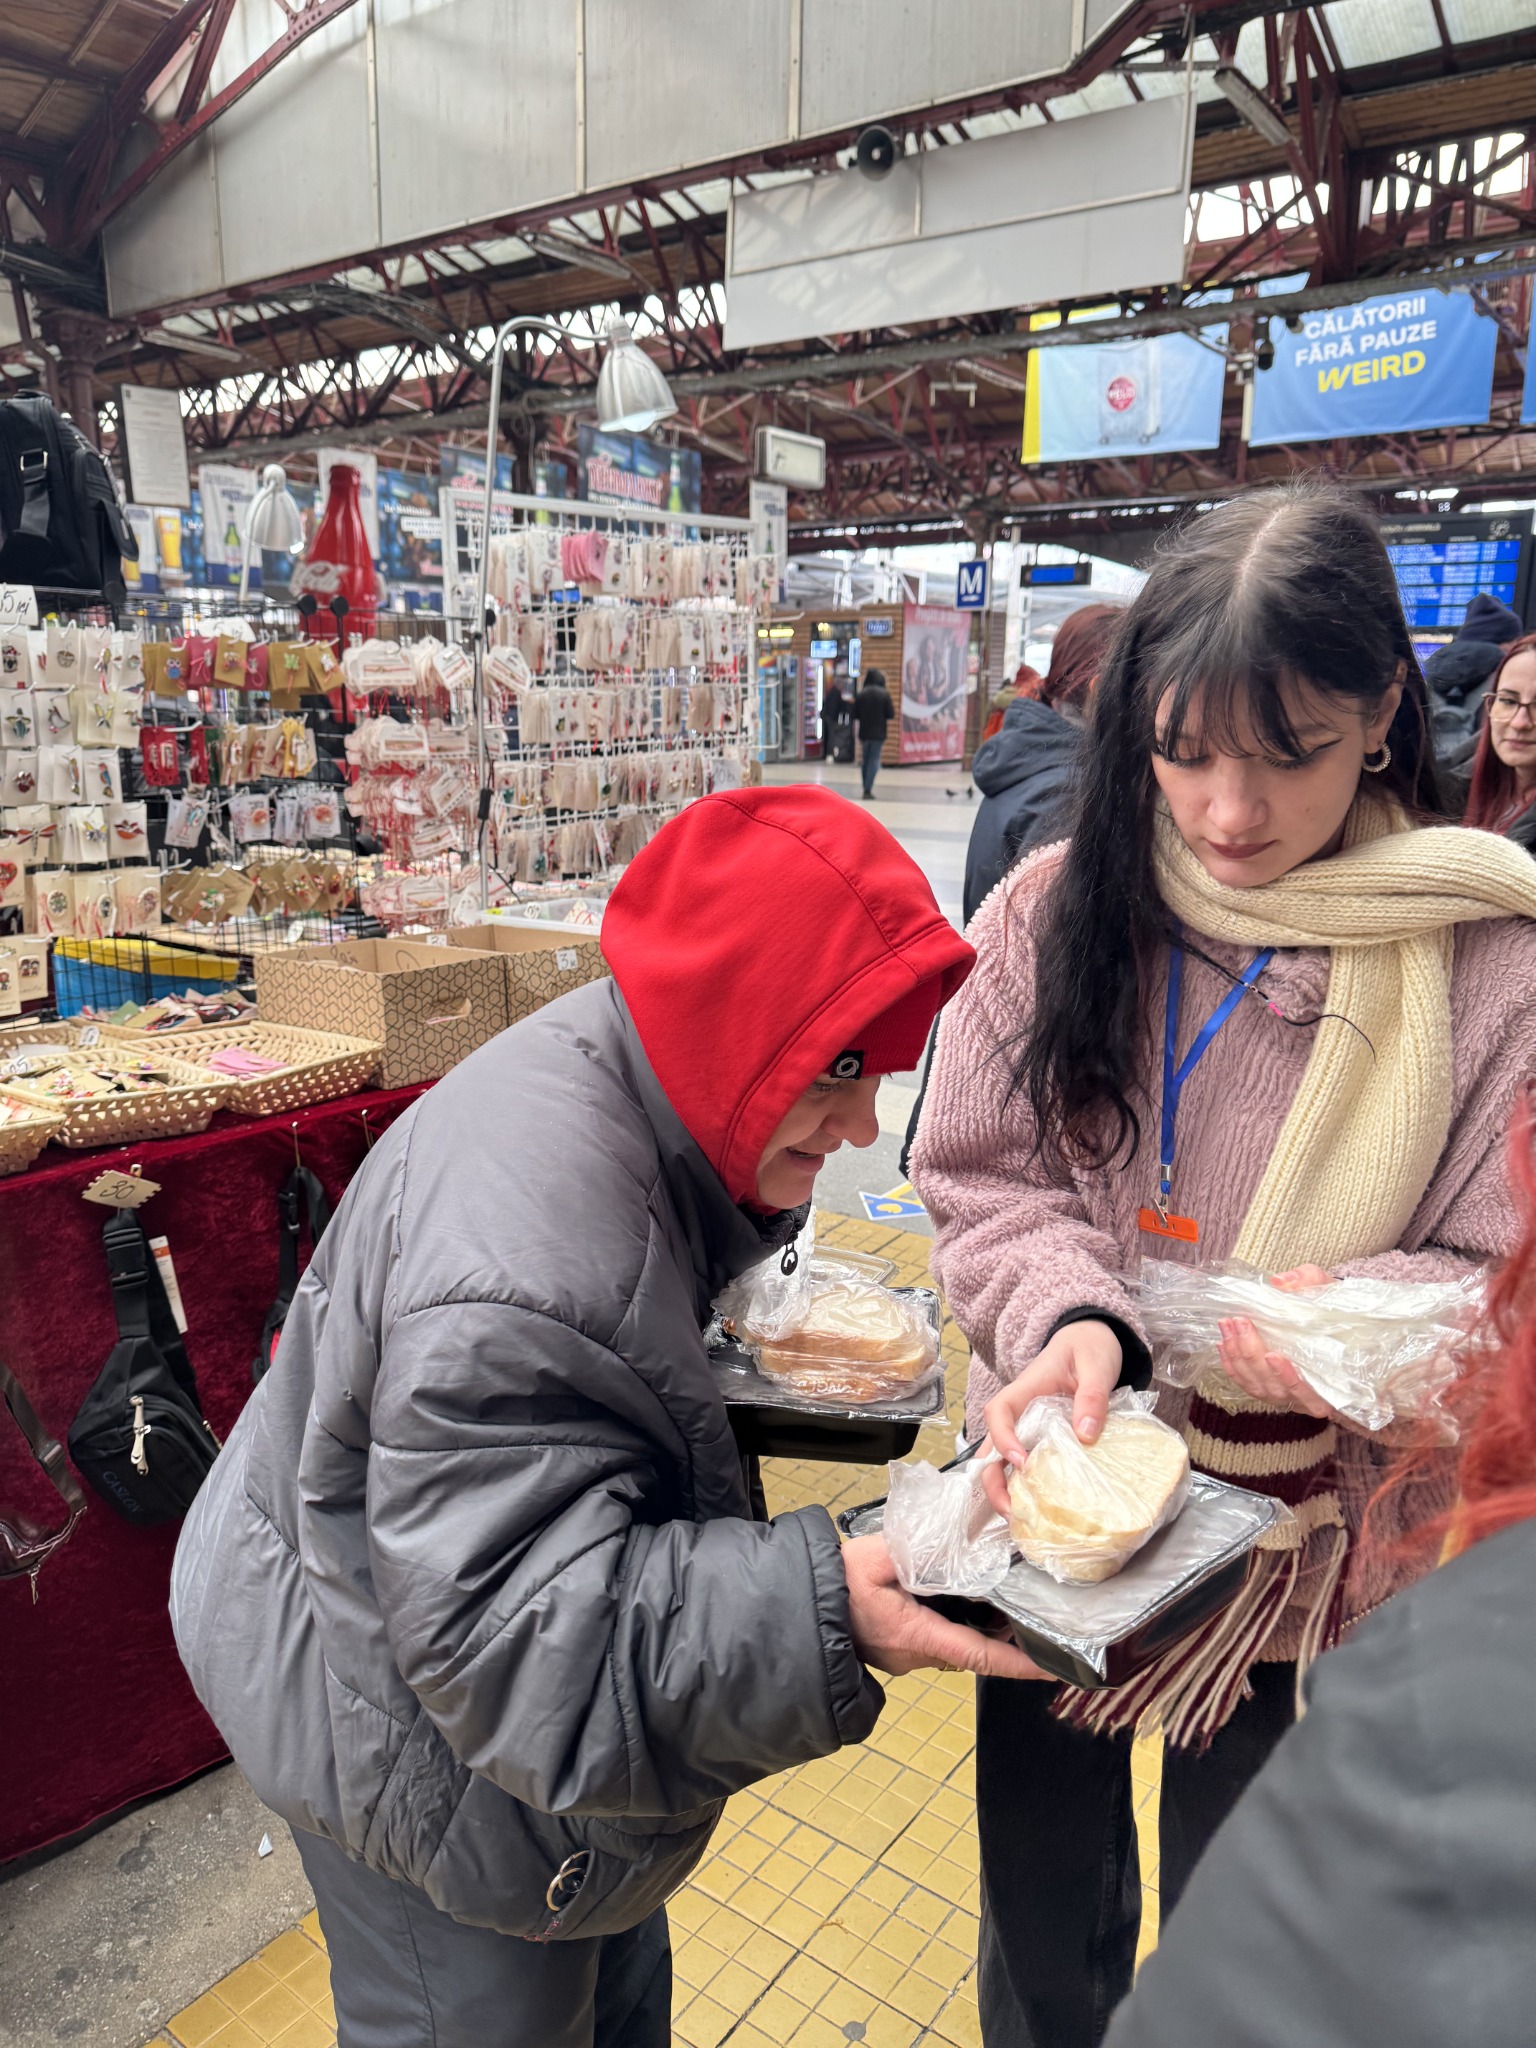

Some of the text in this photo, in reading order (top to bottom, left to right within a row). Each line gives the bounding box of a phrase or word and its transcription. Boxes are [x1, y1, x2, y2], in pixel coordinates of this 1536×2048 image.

[1304, 296, 1426, 339] CĂLĂTORII
[1295, 320, 1437, 367] FĂRĂ PAUZE
[1318, 351, 1426, 394] WEIRD
[960, 566, 983, 595] M
[99, 1180, 136, 1200] 30
